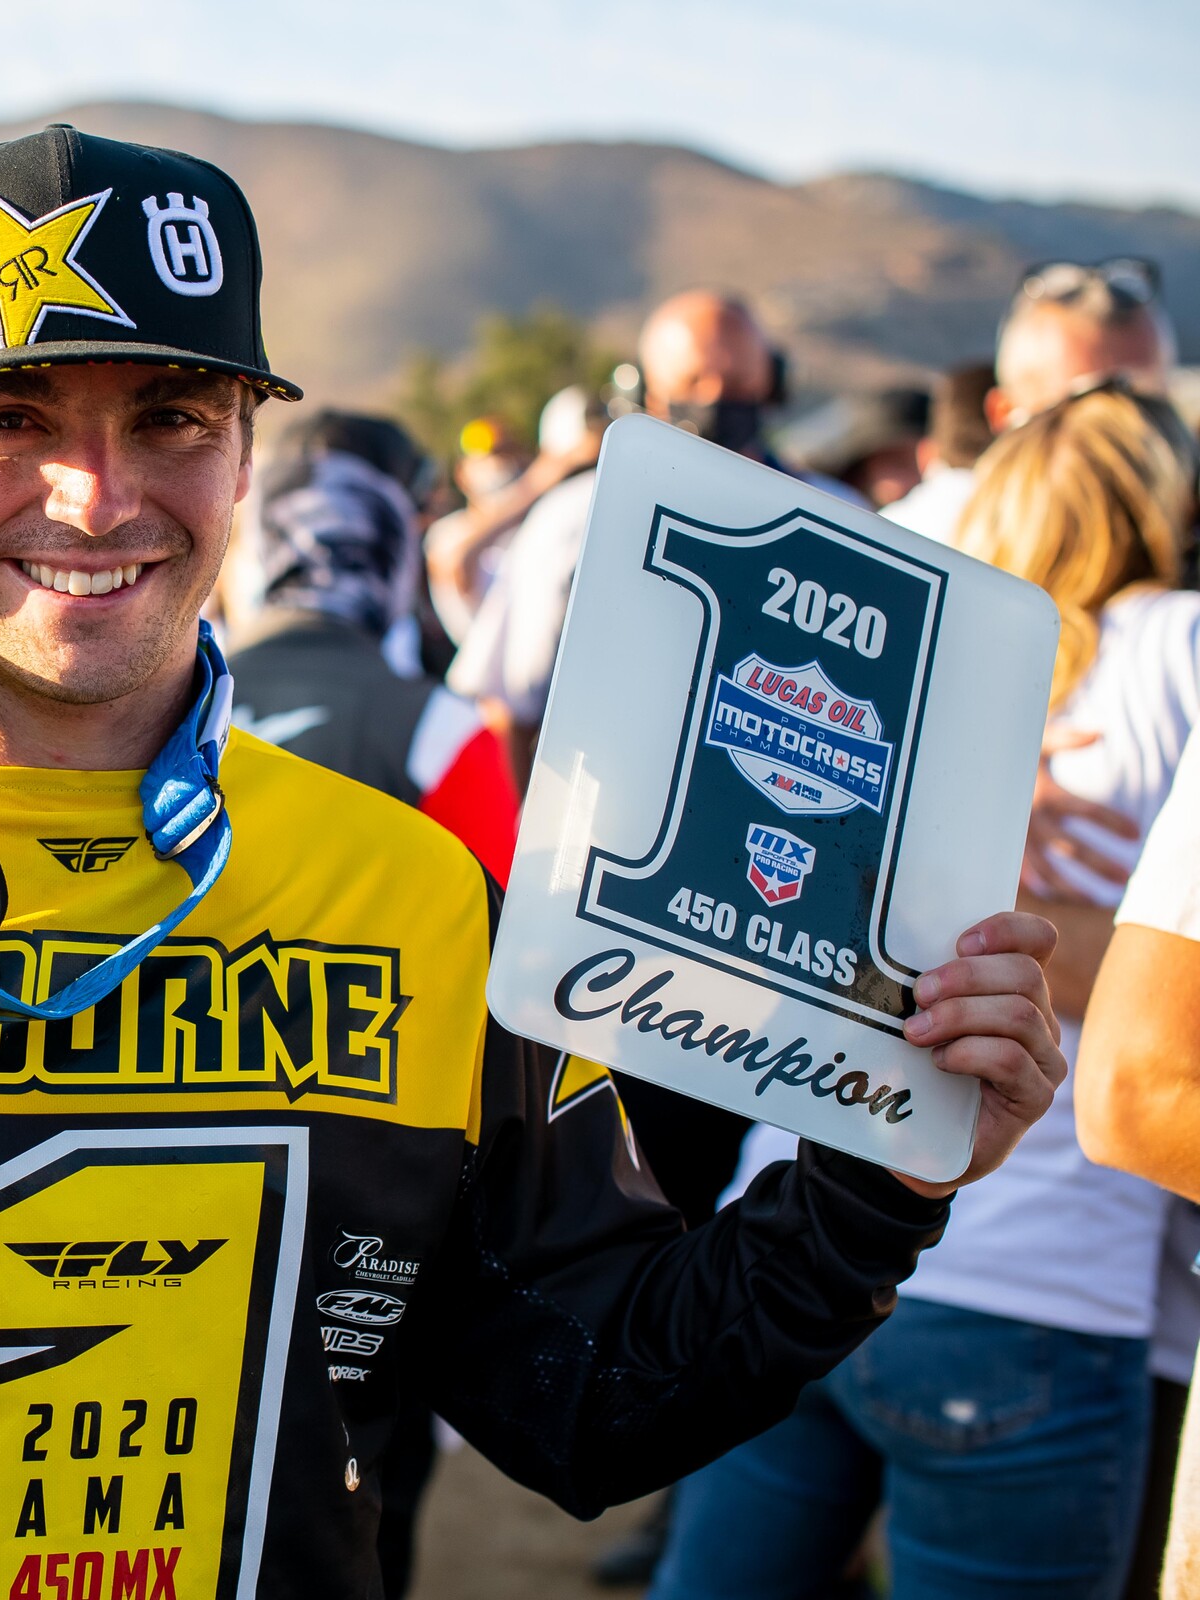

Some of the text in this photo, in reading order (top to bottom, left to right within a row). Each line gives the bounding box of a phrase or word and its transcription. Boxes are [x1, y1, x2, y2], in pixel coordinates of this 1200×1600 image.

[761, 567, 888, 660] 2020
[746, 666, 827, 715] LUCAS
[716, 701, 883, 785] MOTOCROSS
[780, 716, 826, 740] PRO
[713, 722, 879, 793] CHAMPIONSHIP
[762, 771, 801, 796] AMA
[802, 784, 823, 799] PRO
[749, 827, 813, 865] MX
[755, 854, 799, 877] PRO RACING
[667, 887, 858, 987] 450 CLASS
[554, 947, 914, 1125] Champion
[4, 1238, 230, 1278] FLY
[355, 1270, 390, 1280] CHEVROLET
[52, 1278, 182, 1290] RACING
[318, 1293, 406, 1317] FMF
[22, 1397, 198, 1462] 2020
[14, 1472, 185, 1538] AMA
